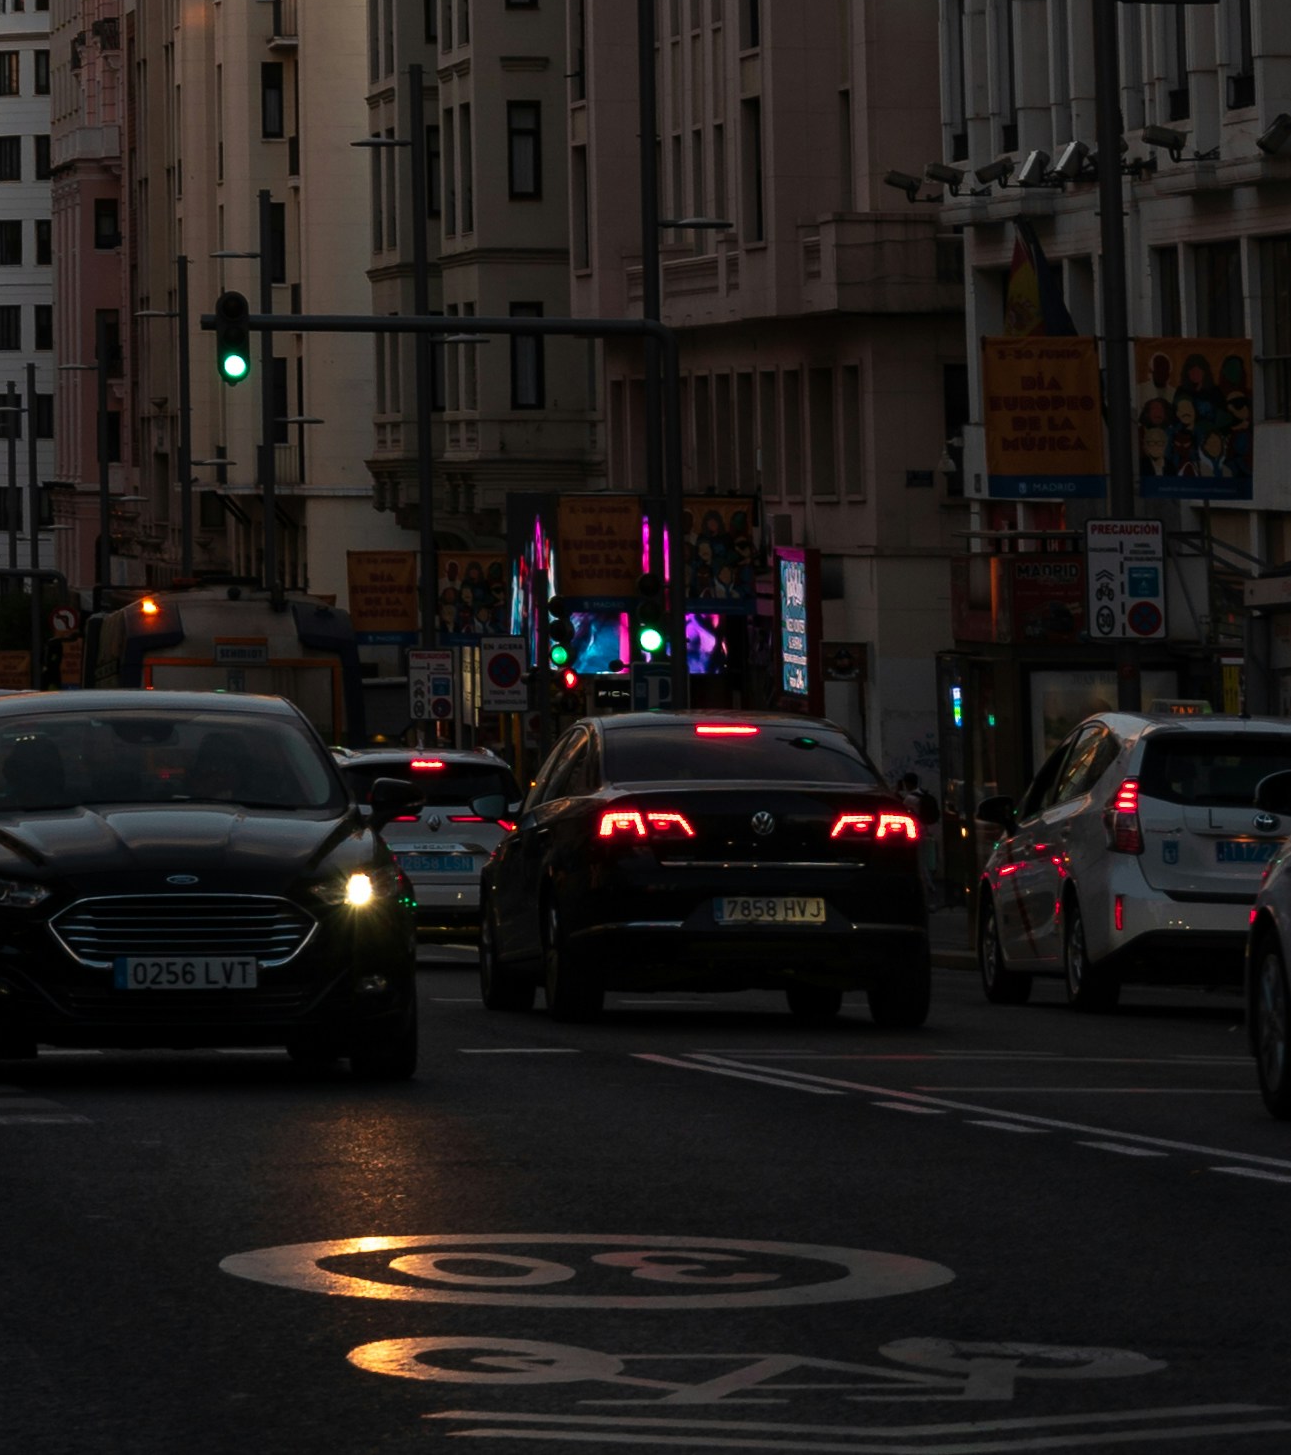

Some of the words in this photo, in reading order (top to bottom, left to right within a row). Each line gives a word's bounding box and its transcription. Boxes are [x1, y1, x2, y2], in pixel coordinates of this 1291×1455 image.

[1021, 372, 1062, 391] DÍA
[989, 395, 1095, 412] EUROPEO
[1011, 416, 1042, 432] DE
[1048, 415, 1077, 431] LA
[1001, 433, 1088, 452] MÚSICA
[1031, 483, 1077, 494] MADRID
[1091, 523, 1160, 534] PRECAUCIÓN
[1017, 564, 1079, 578] MADRID
[1100, 615, 1112, 625] 30
[220, 648, 263, 658] SCHMIDT
[727, 900, 777, 918] 7858
[784, 900, 821, 918] HVJ
[133, 962, 196, 985] 0256
[205, 961, 251, 985] LVT
